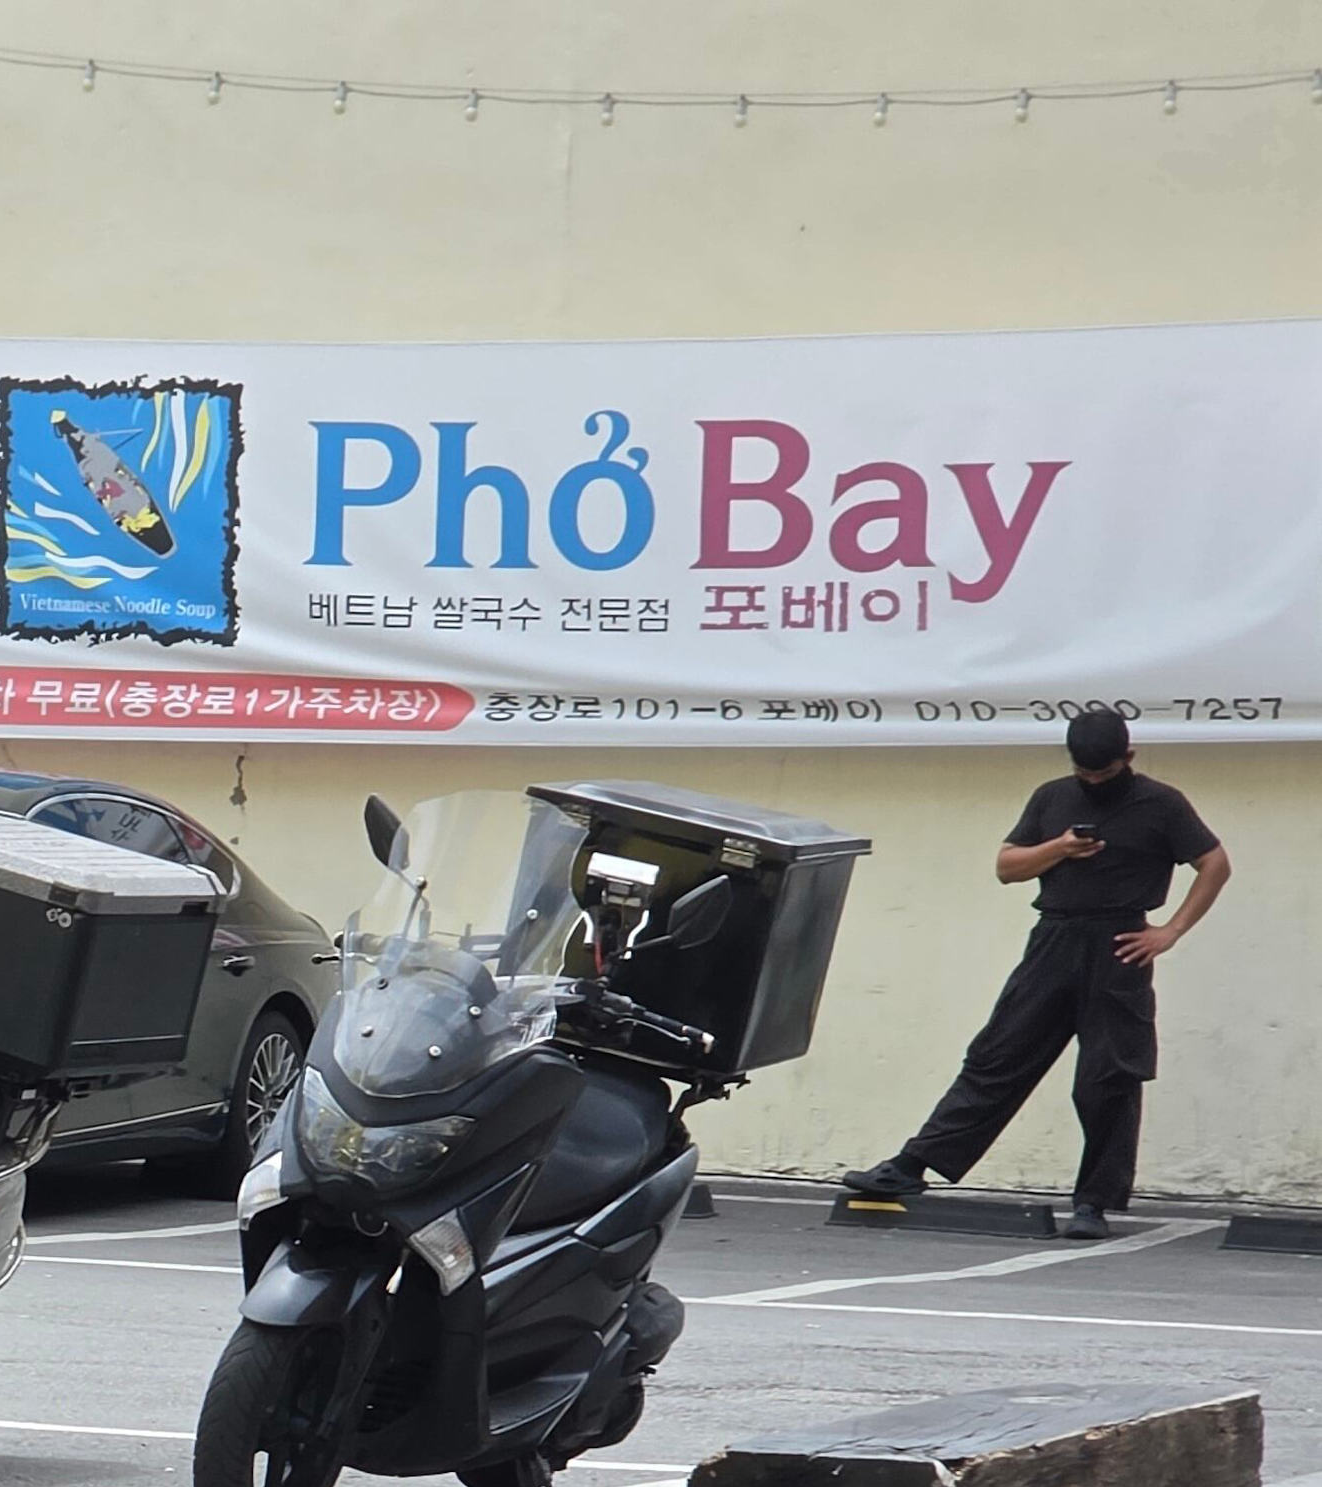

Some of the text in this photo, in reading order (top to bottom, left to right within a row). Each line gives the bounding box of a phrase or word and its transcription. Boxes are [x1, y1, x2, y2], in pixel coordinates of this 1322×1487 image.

[688, 419, 1074, 604] Bay
[19, 592, 217, 620] Vietnamese Noodle Soup
[308, 593, 671, 633] 베트남 쌀국수 전문점
[698, 580, 929, 633] 포베이
[756, 699, 884, 723] 포베이
